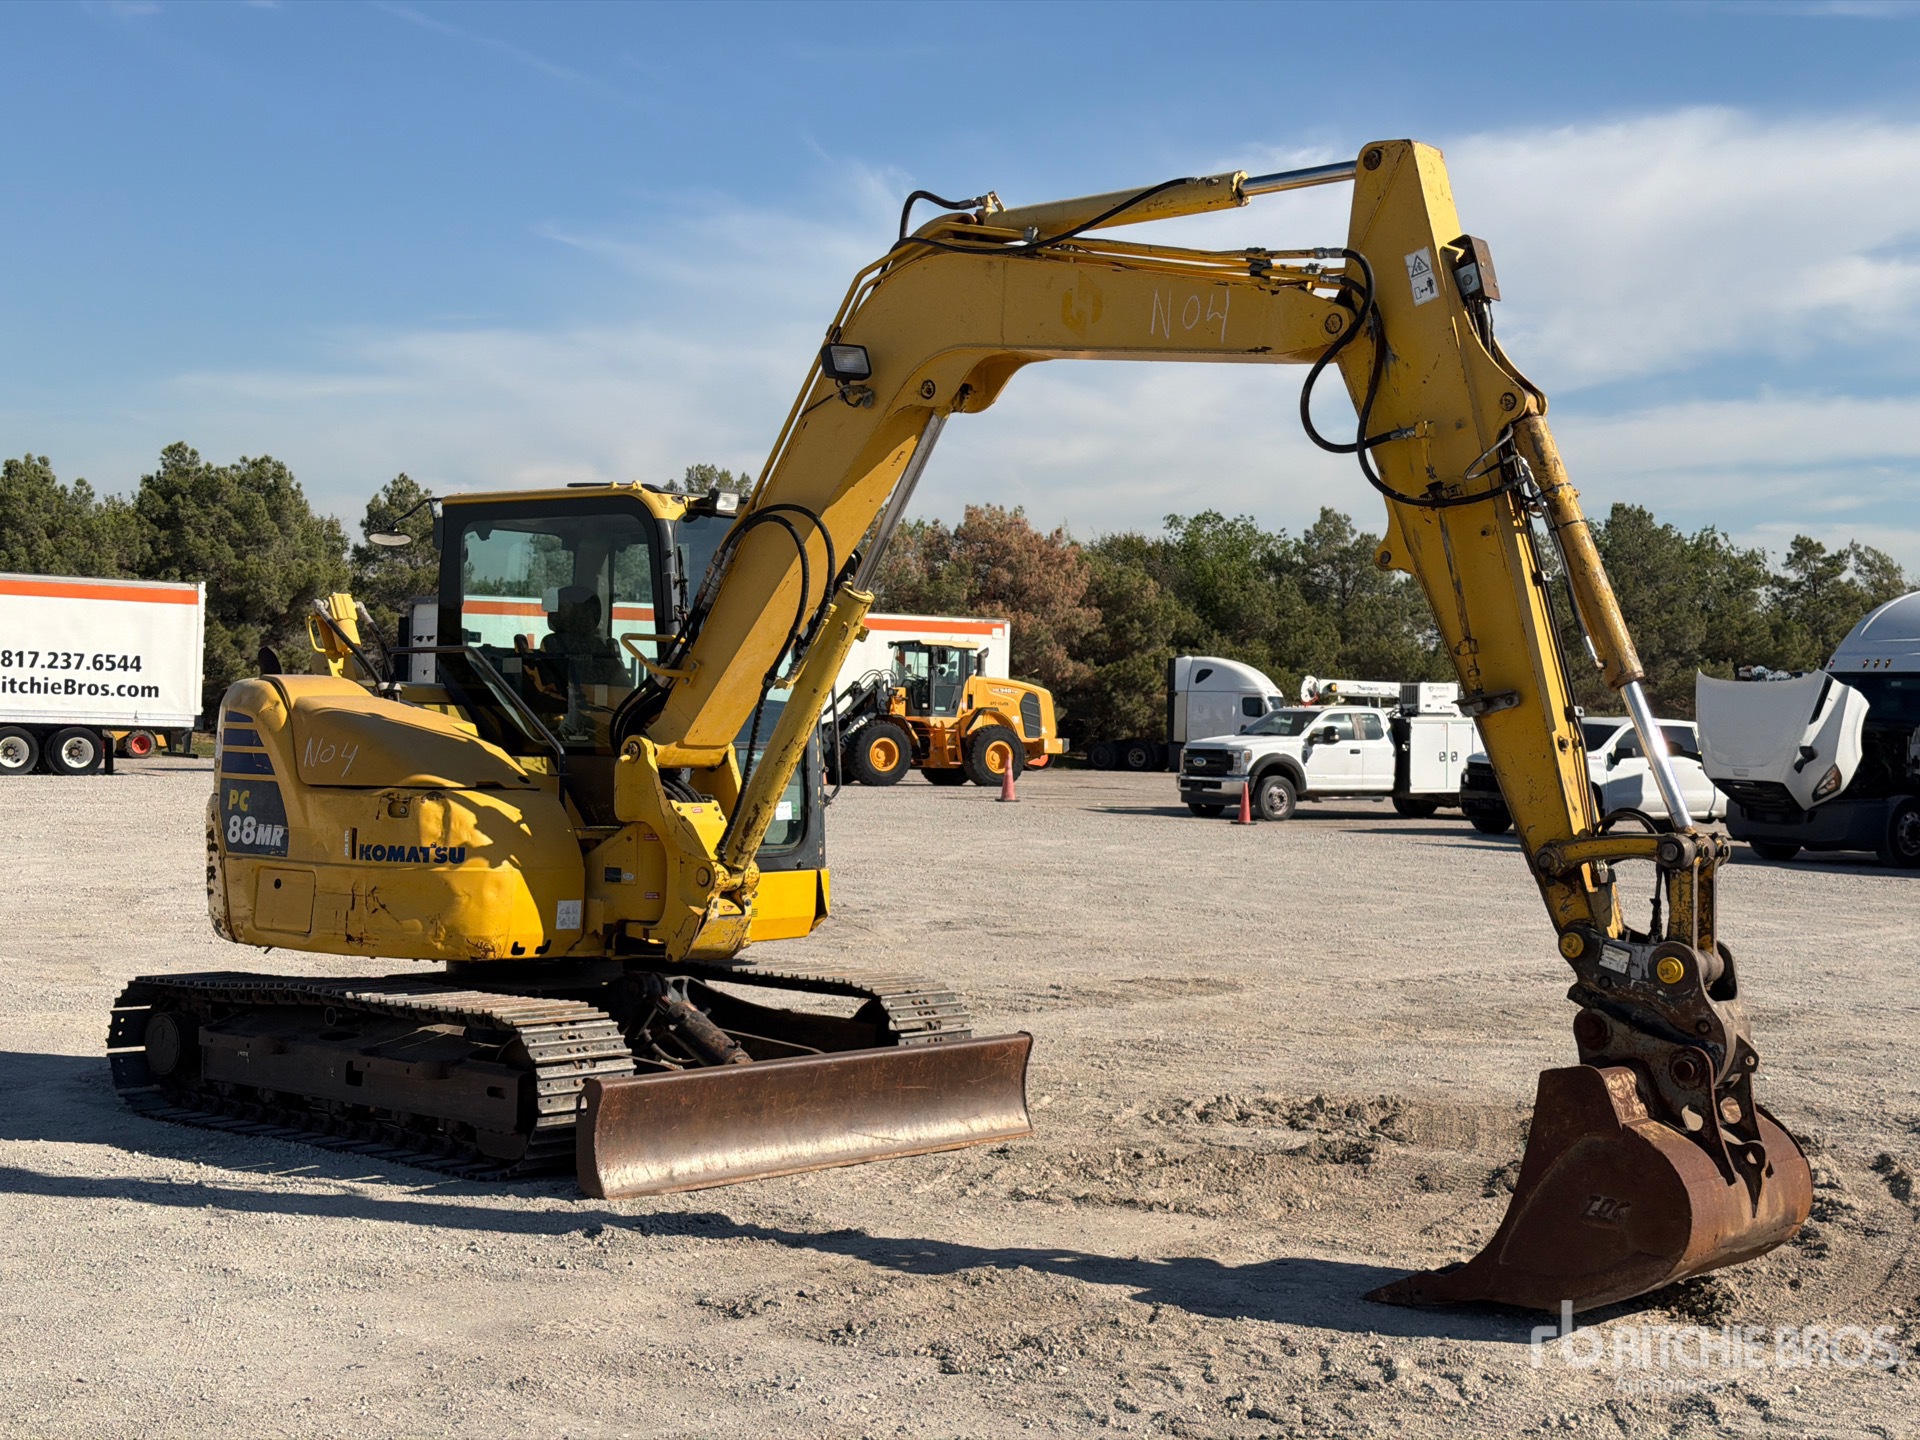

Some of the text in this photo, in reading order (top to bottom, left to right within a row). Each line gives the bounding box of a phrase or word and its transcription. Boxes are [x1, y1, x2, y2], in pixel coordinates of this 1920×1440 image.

[0, 649, 142, 672] 817.237.6544
[228, 789, 251, 812] PC
[227, 815, 284, 847] 88MR
[359, 843, 466, 865] KOMATSU
